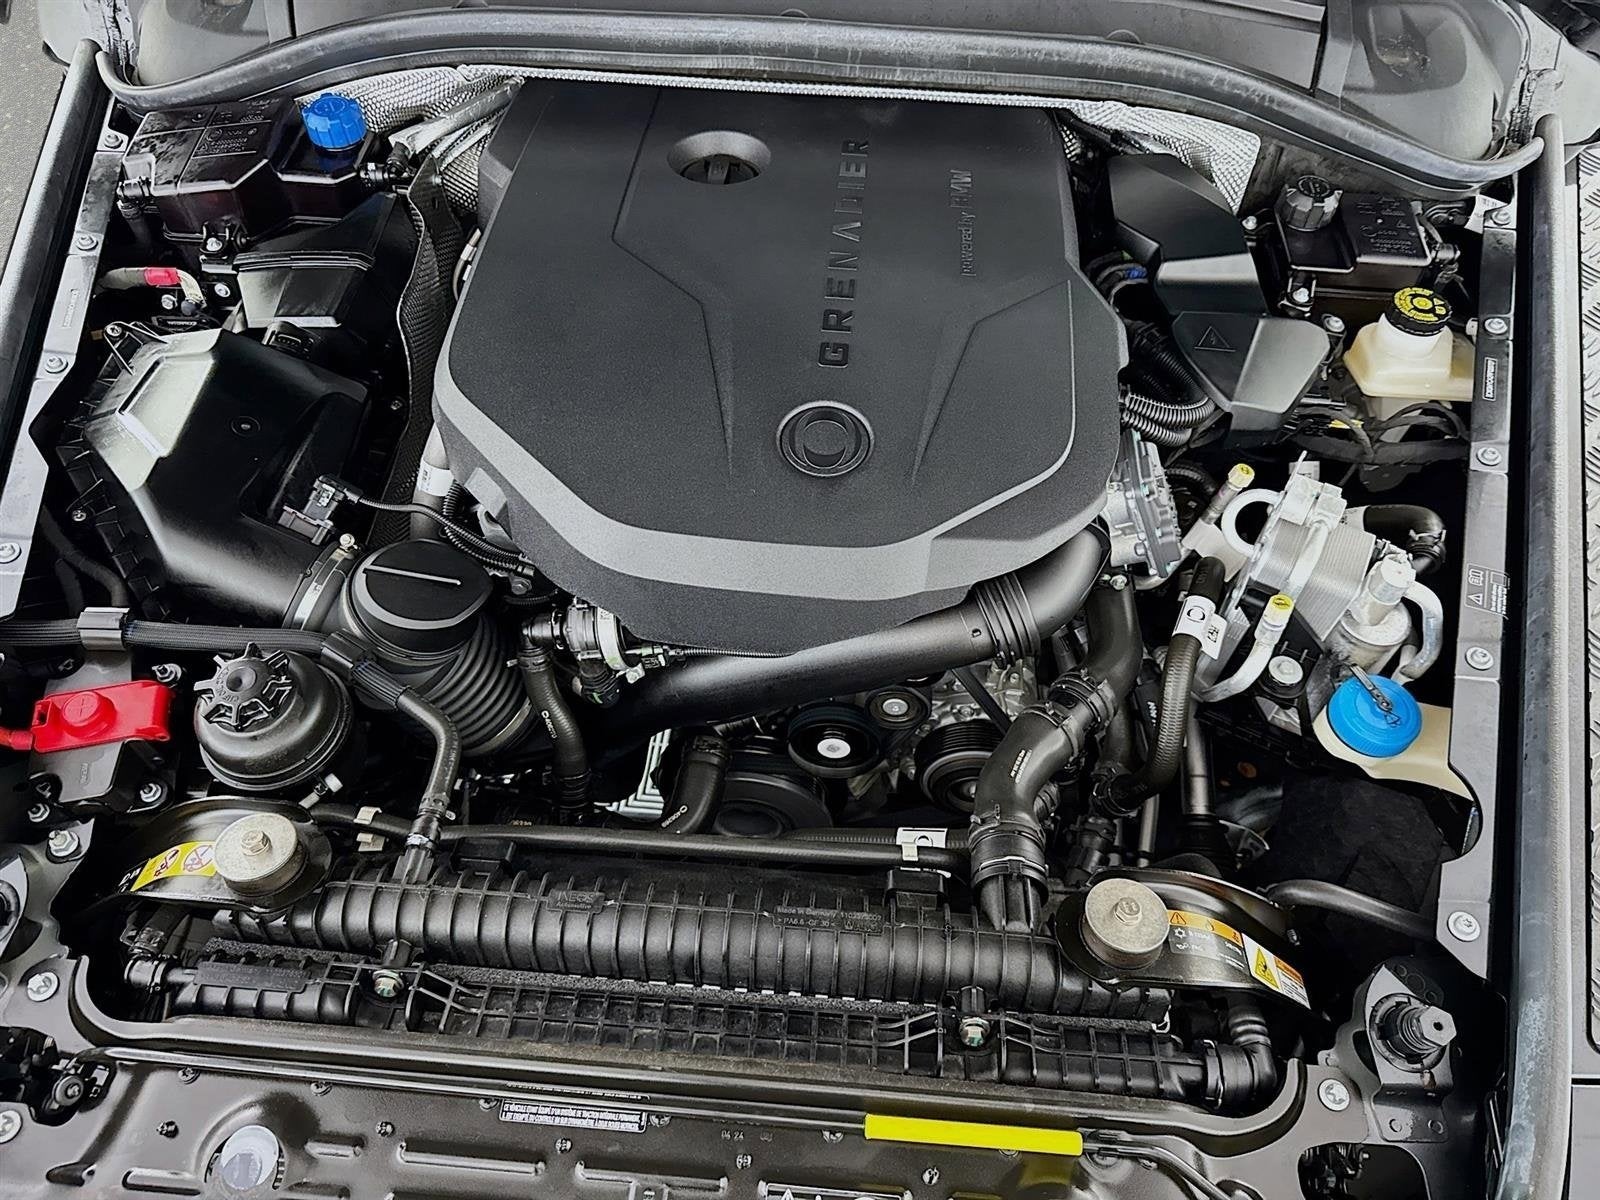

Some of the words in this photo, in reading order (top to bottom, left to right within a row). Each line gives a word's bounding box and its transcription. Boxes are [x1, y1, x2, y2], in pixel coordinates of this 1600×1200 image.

[950, 169, 972, 207] BMW
[959, 211, 976, 225] by
[817, 140, 869, 368] GRENADIER
[958, 226, 976, 276] powered
